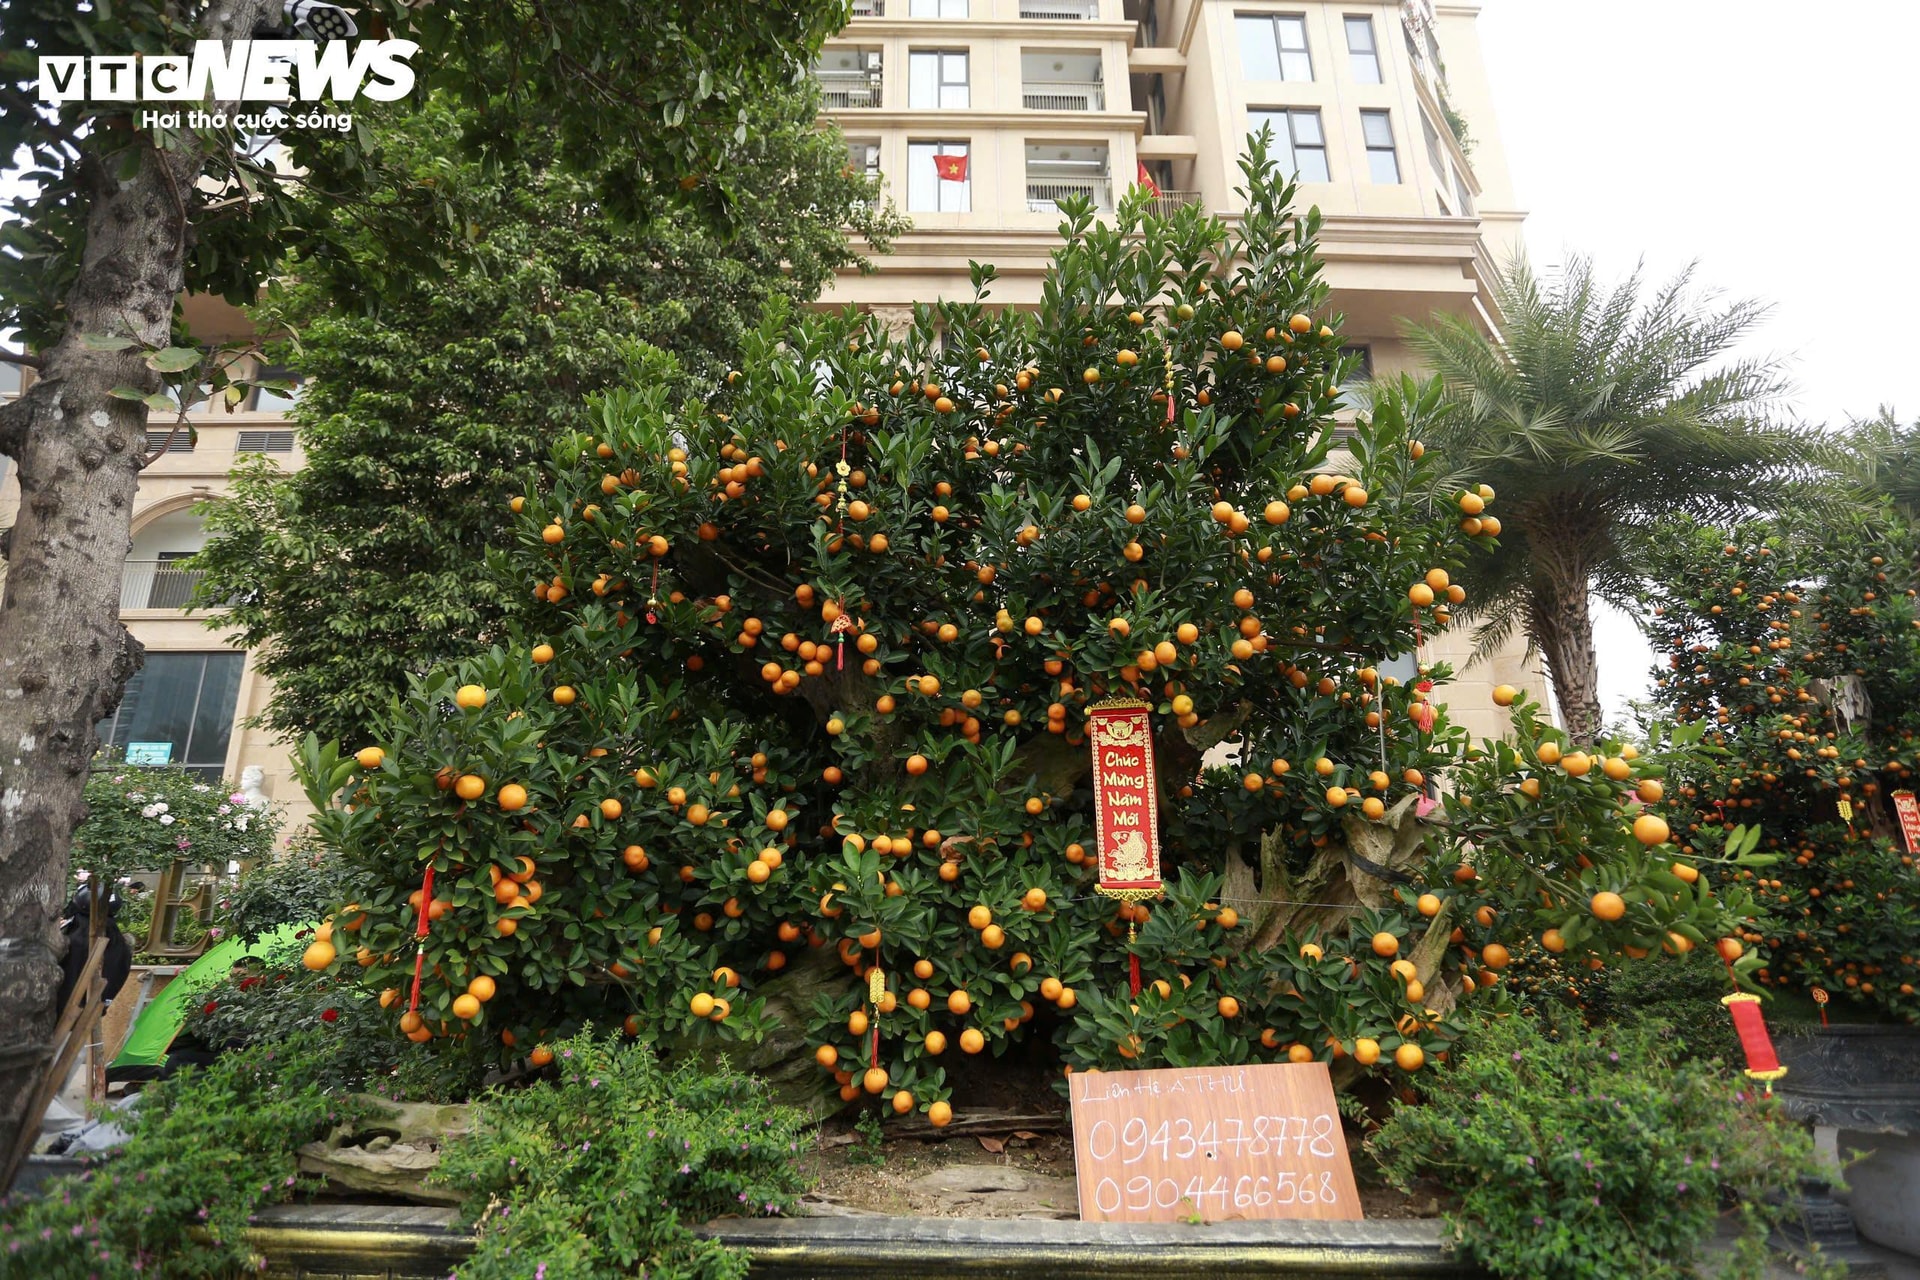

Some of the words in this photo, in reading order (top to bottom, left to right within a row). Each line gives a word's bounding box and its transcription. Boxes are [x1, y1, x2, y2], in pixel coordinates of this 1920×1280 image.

[1105, 751, 1139, 767] Chúc
[1103, 771, 1144, 789] Mừng
[1107, 790, 1142, 806] Năm
[1081, 1077, 1130, 1103] Liên
[1089, 1114, 1335, 1164] 0943478778
[1095, 1170, 1336, 1212] 0904466568
